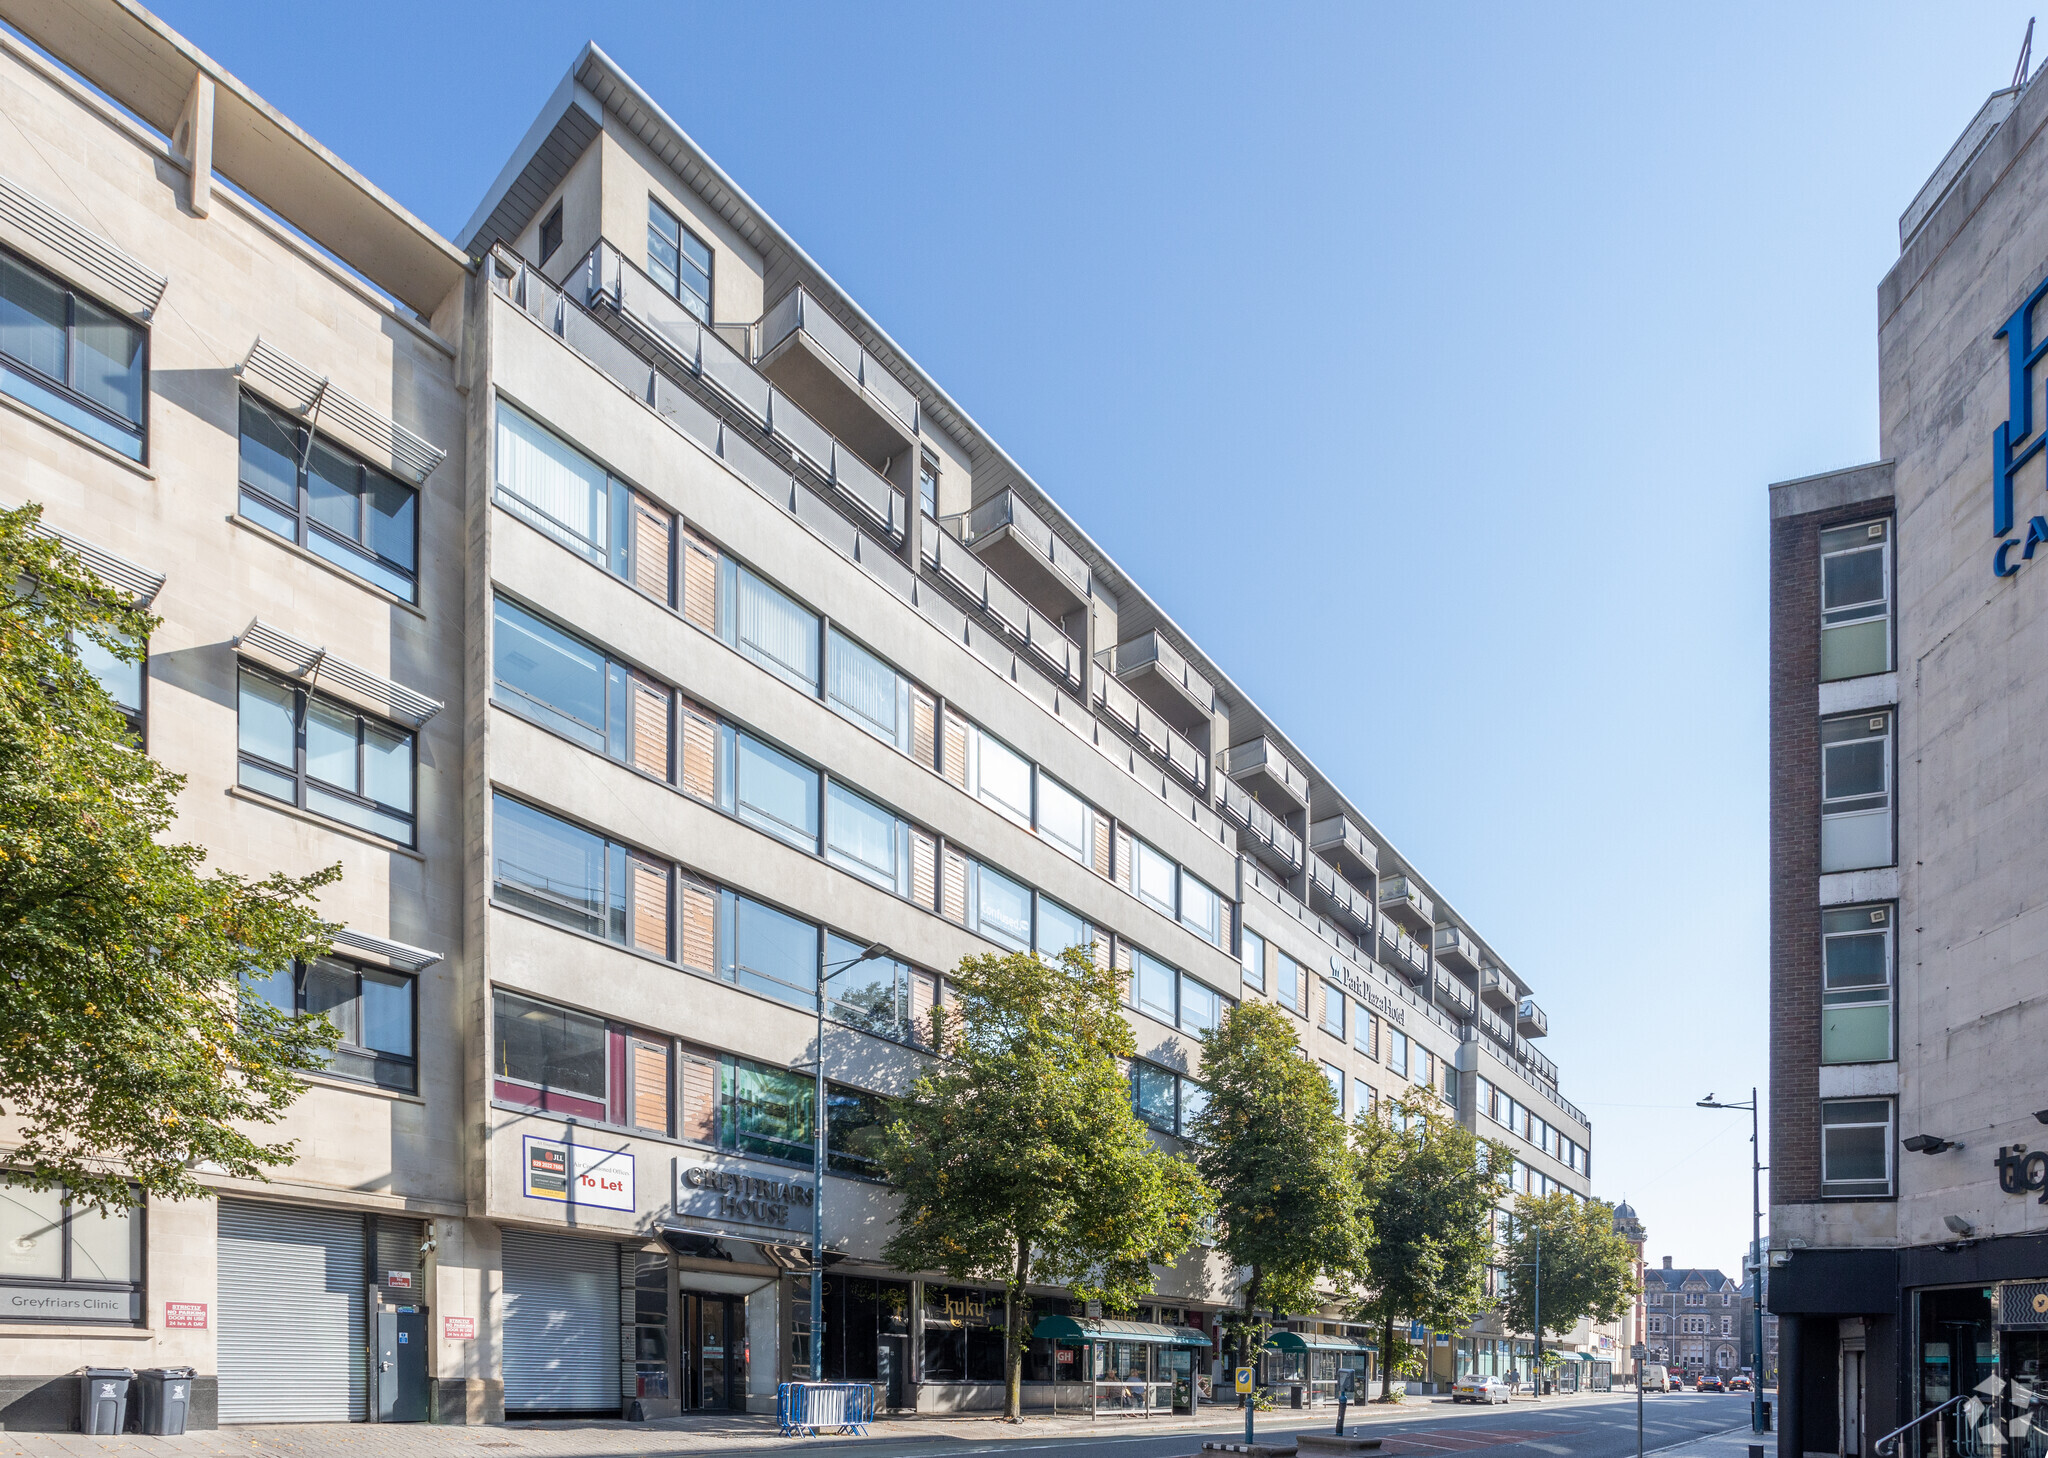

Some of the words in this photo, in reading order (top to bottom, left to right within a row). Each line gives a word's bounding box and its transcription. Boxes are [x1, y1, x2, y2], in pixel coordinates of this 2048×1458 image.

[1343, 966, 1362, 998] Park
[1362, 980, 1384, 1012] Plaza
[1384, 995, 1405, 1027] Hotel
[553, 1153, 564, 1162] JLL
[580, 1174, 596, 1188] To
[601, 1177, 623, 1192] Let
[720, 1195, 789, 1224] HOUSE
[11, 1296, 80, 1308] Greyfriars
[83, 1299, 119, 1310] Clinic
[943, 1293, 984, 1319] kuku
[1057, 1351, 1071, 1362] GH
